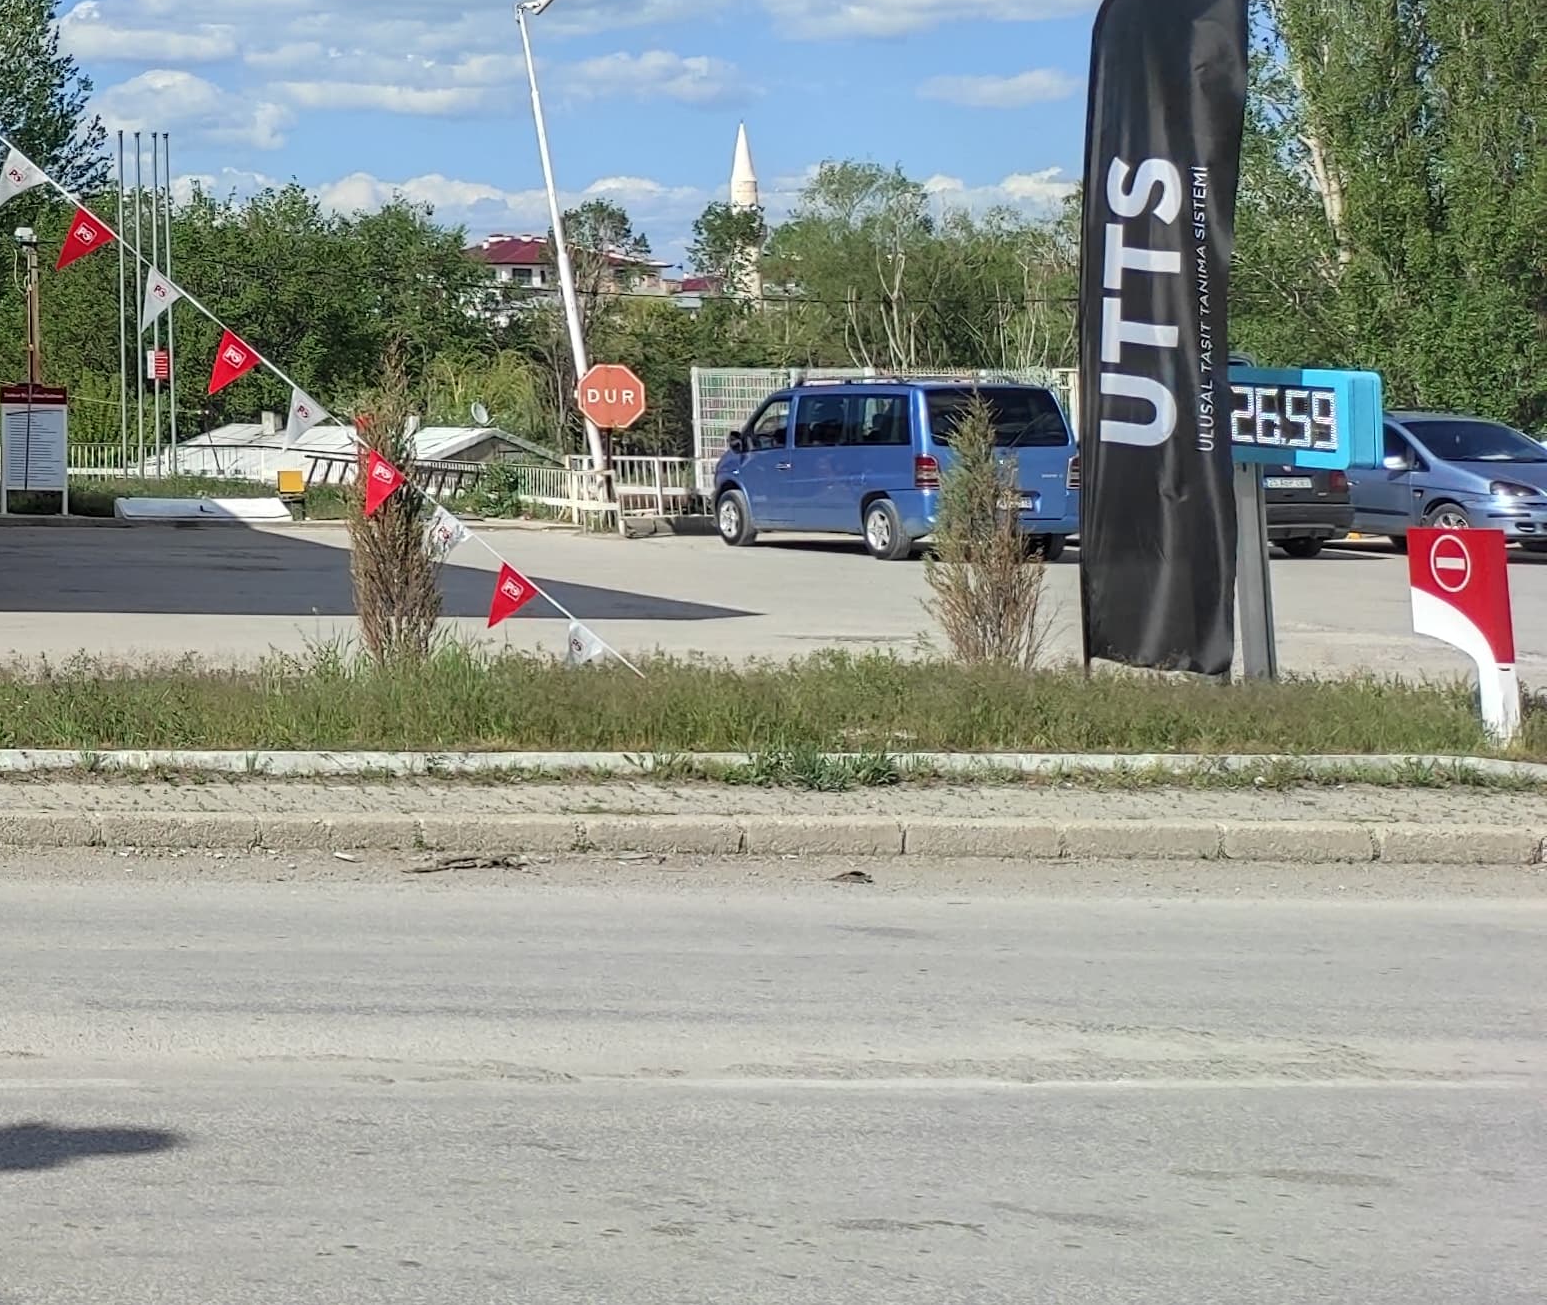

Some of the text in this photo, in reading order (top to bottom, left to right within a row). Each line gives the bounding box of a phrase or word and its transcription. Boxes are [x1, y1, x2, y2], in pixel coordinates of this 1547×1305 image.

[1100, 156, 1182, 447] UTTS
[1197, 245, 1210, 315] TANIMA
[1200, 322, 1213, 373] TAŞIT
[587, 388, 634, 405] DUR
[1197, 379, 1215, 452] ULUSAL
[1230, 386, 1339, 450] 26.59
